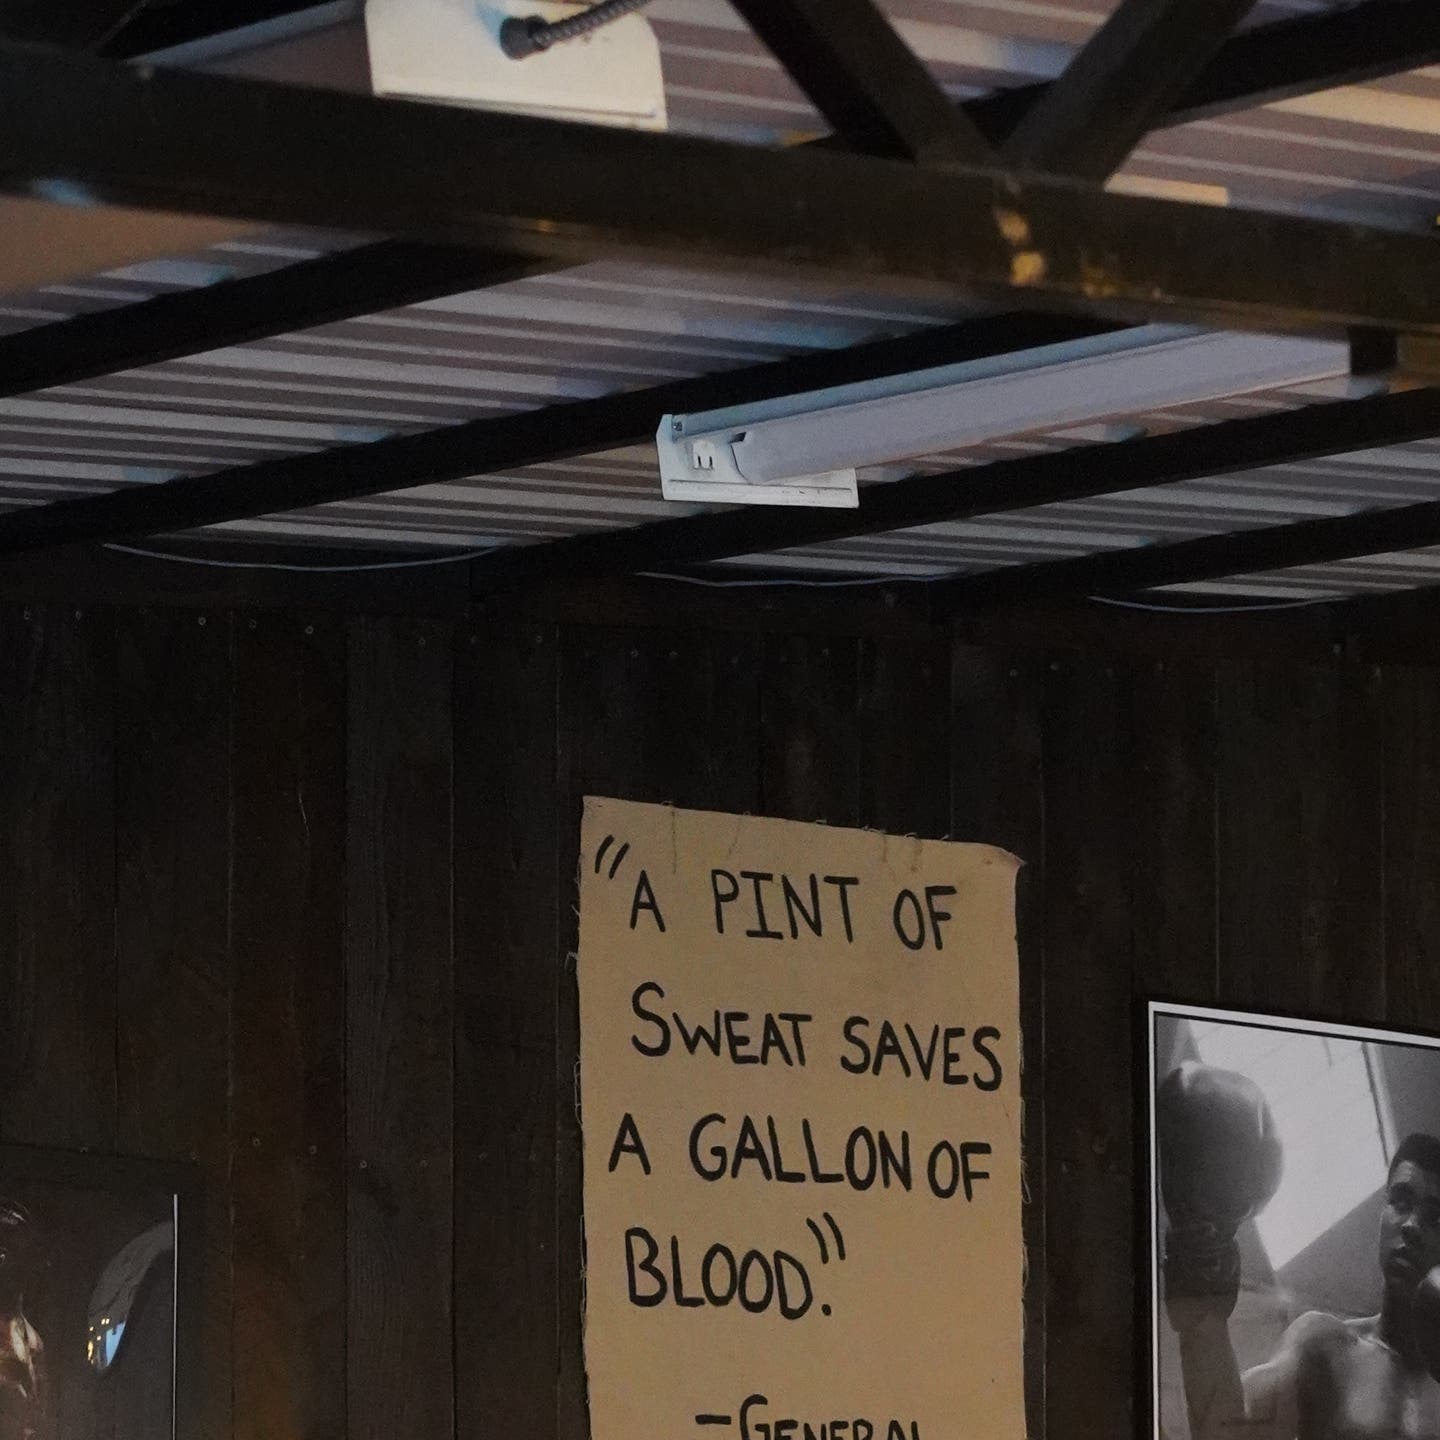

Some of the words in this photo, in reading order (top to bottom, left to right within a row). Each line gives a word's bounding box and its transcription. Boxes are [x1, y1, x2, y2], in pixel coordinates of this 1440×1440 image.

[714, 869, 861, 944] PINT
[893, 884, 957, 951] OF
[840, 1015, 1002, 1092] SAVES
[608, 1113, 652, 1176] A
[688, 1112, 912, 1193] GALLON
[926, 1140, 993, 1202] OF
